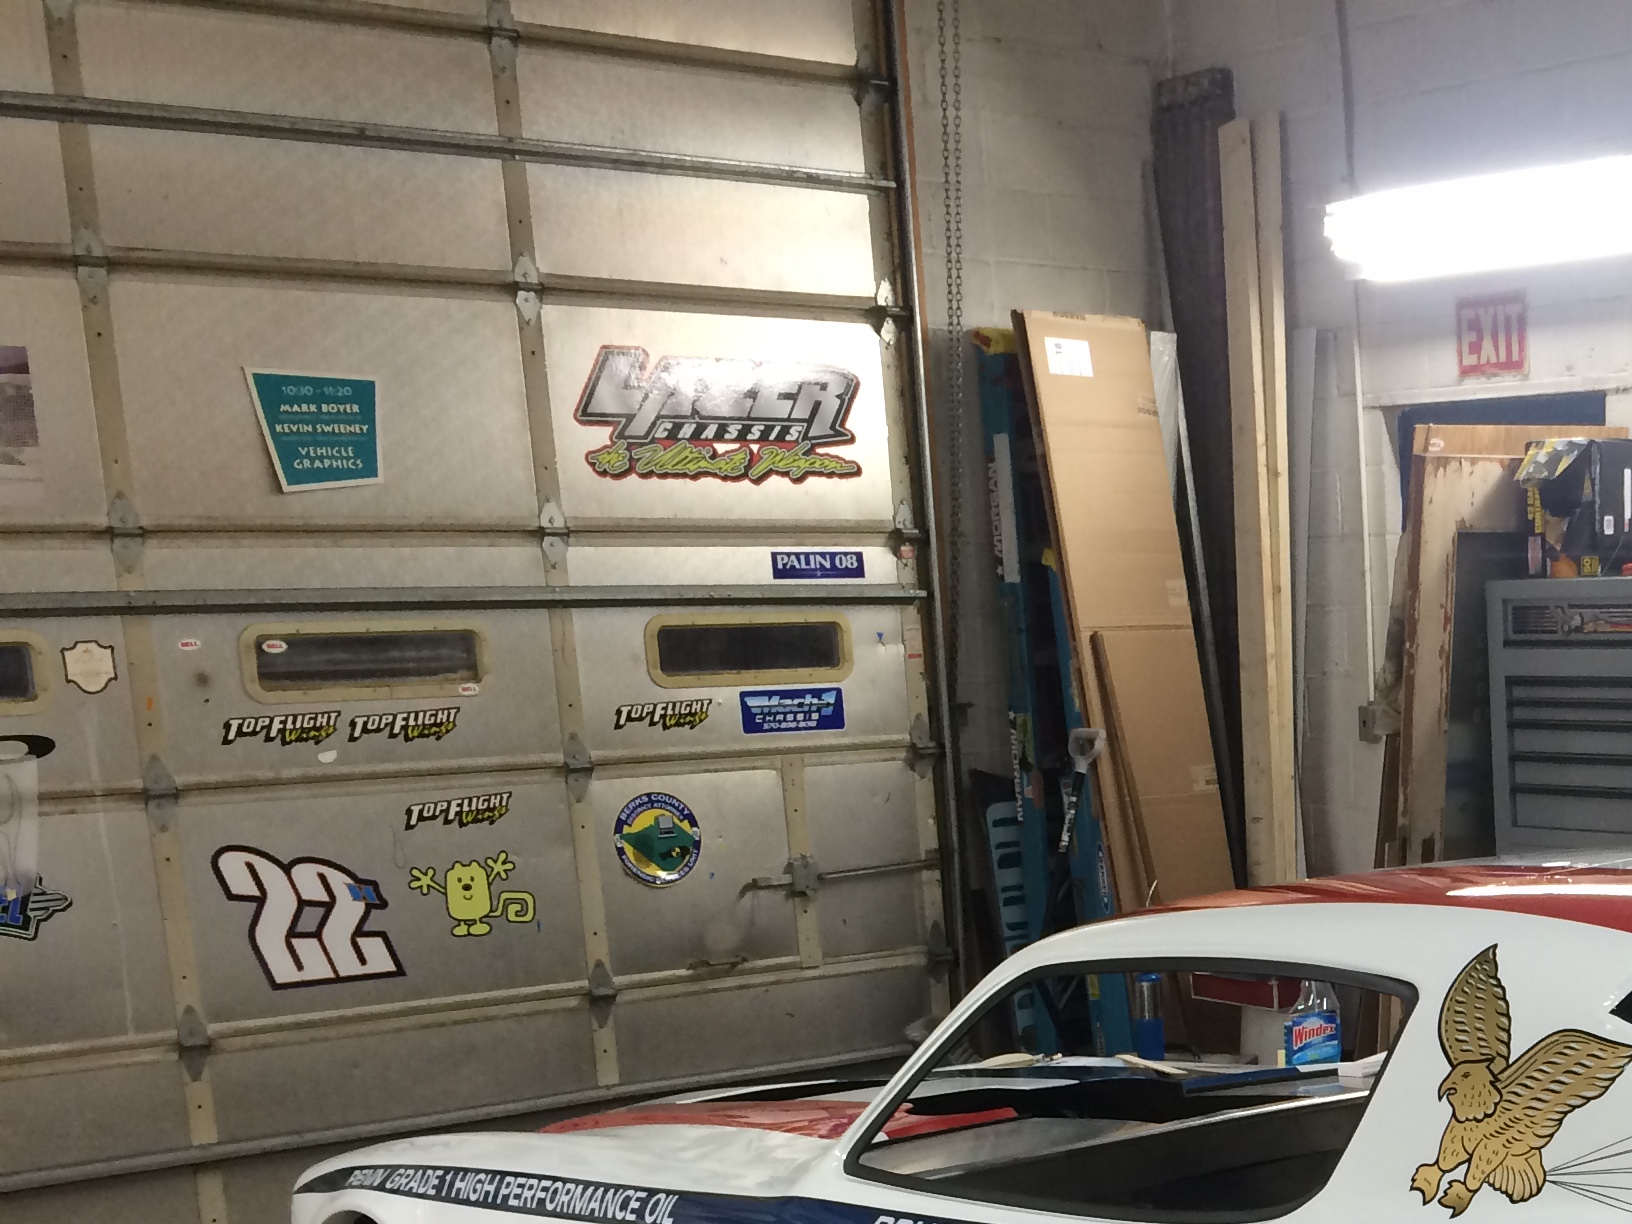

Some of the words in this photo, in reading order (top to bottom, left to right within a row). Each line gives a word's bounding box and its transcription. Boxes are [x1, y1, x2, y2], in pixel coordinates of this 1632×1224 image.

[1461, 306, 1523, 366] EXIT
[279, 403, 318, 413] MARK
[321, 403, 360, 413] BOYER
[275, 424, 313, 433] KEVIN
[316, 423, 369, 434] SWEENEY
[654, 421, 804, 441] CHASSIS
[293, 458, 364, 470] GRAPHICS
[298, 446, 355, 457] VEHICLE
[633, 441, 748, 476] Ultimate
[988, 461, 1003, 558] MORGAN
[776, 554, 832, 571] PALIN
[834, 554, 859, 570] 08
[755, 712, 820, 723] CHASSIS
[1009, 729, 1024, 821] MORGAN
[620, 795, 649, 820] BERKS
[651, 793, 690, 815] COUNTY
[211, 844, 407, 991] 22
[1293, 1023, 1337, 1051] Windex
[346, 1169, 390, 1186] PENN
[385, 1168, 444, 1196] GRADE
[441, 1170, 454, 1197] 1
[451, 1171, 501, 1203] HIGH
[497, 1176, 643, 1221] PERFORMANCE
